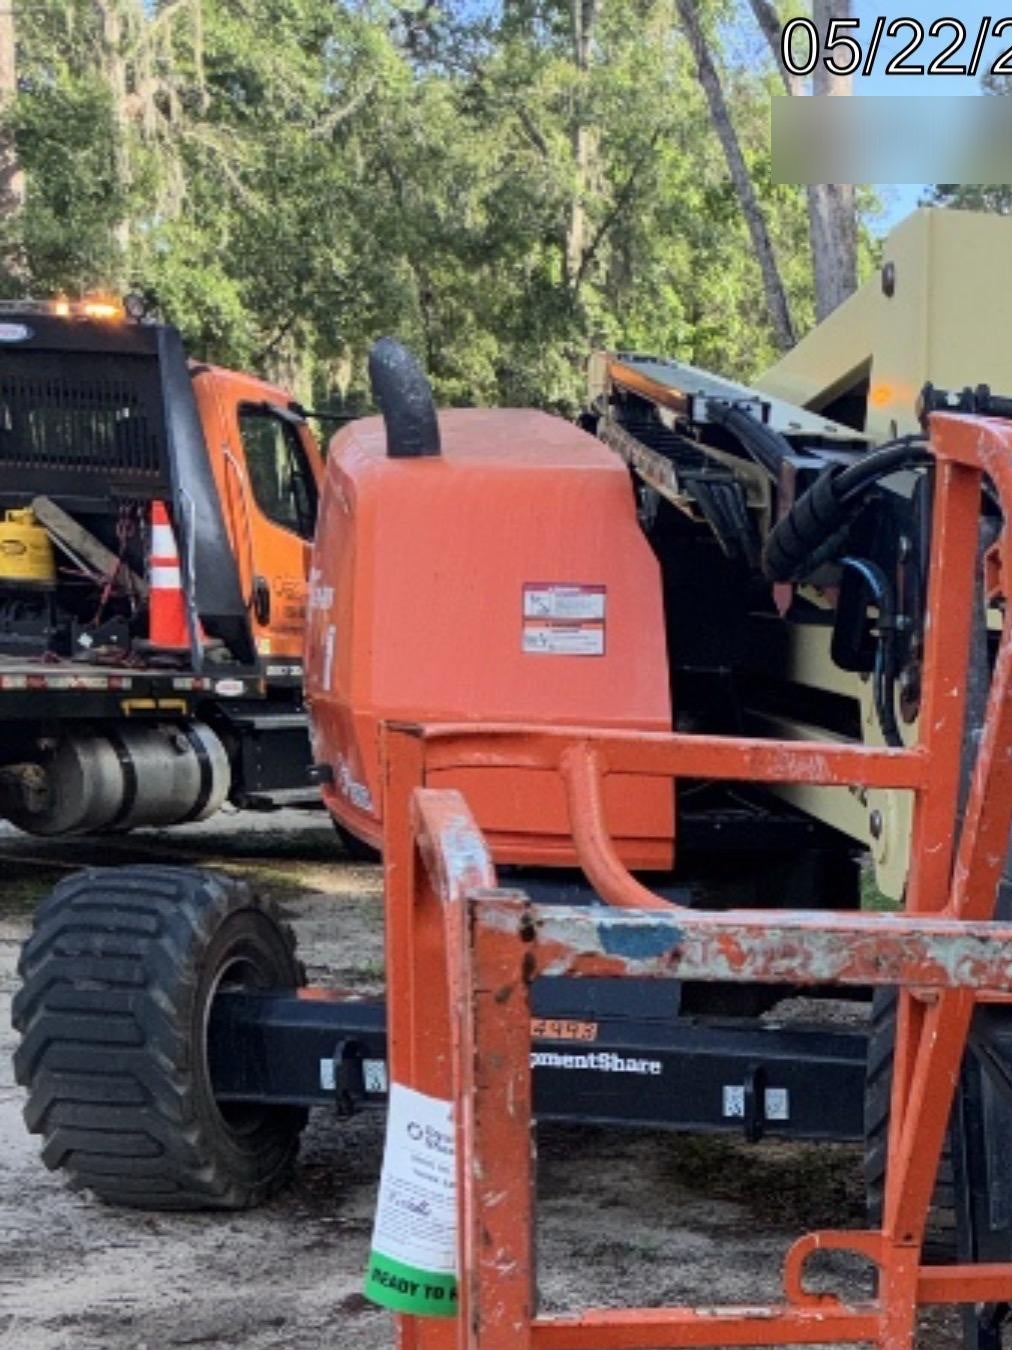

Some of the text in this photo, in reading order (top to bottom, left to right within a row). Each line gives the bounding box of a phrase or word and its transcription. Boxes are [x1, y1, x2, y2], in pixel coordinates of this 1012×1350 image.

[530, 1052, 661, 1075] pmentShare
[371, 1268, 420, 1297] READY
[424, 1284, 445, 1300] TO
